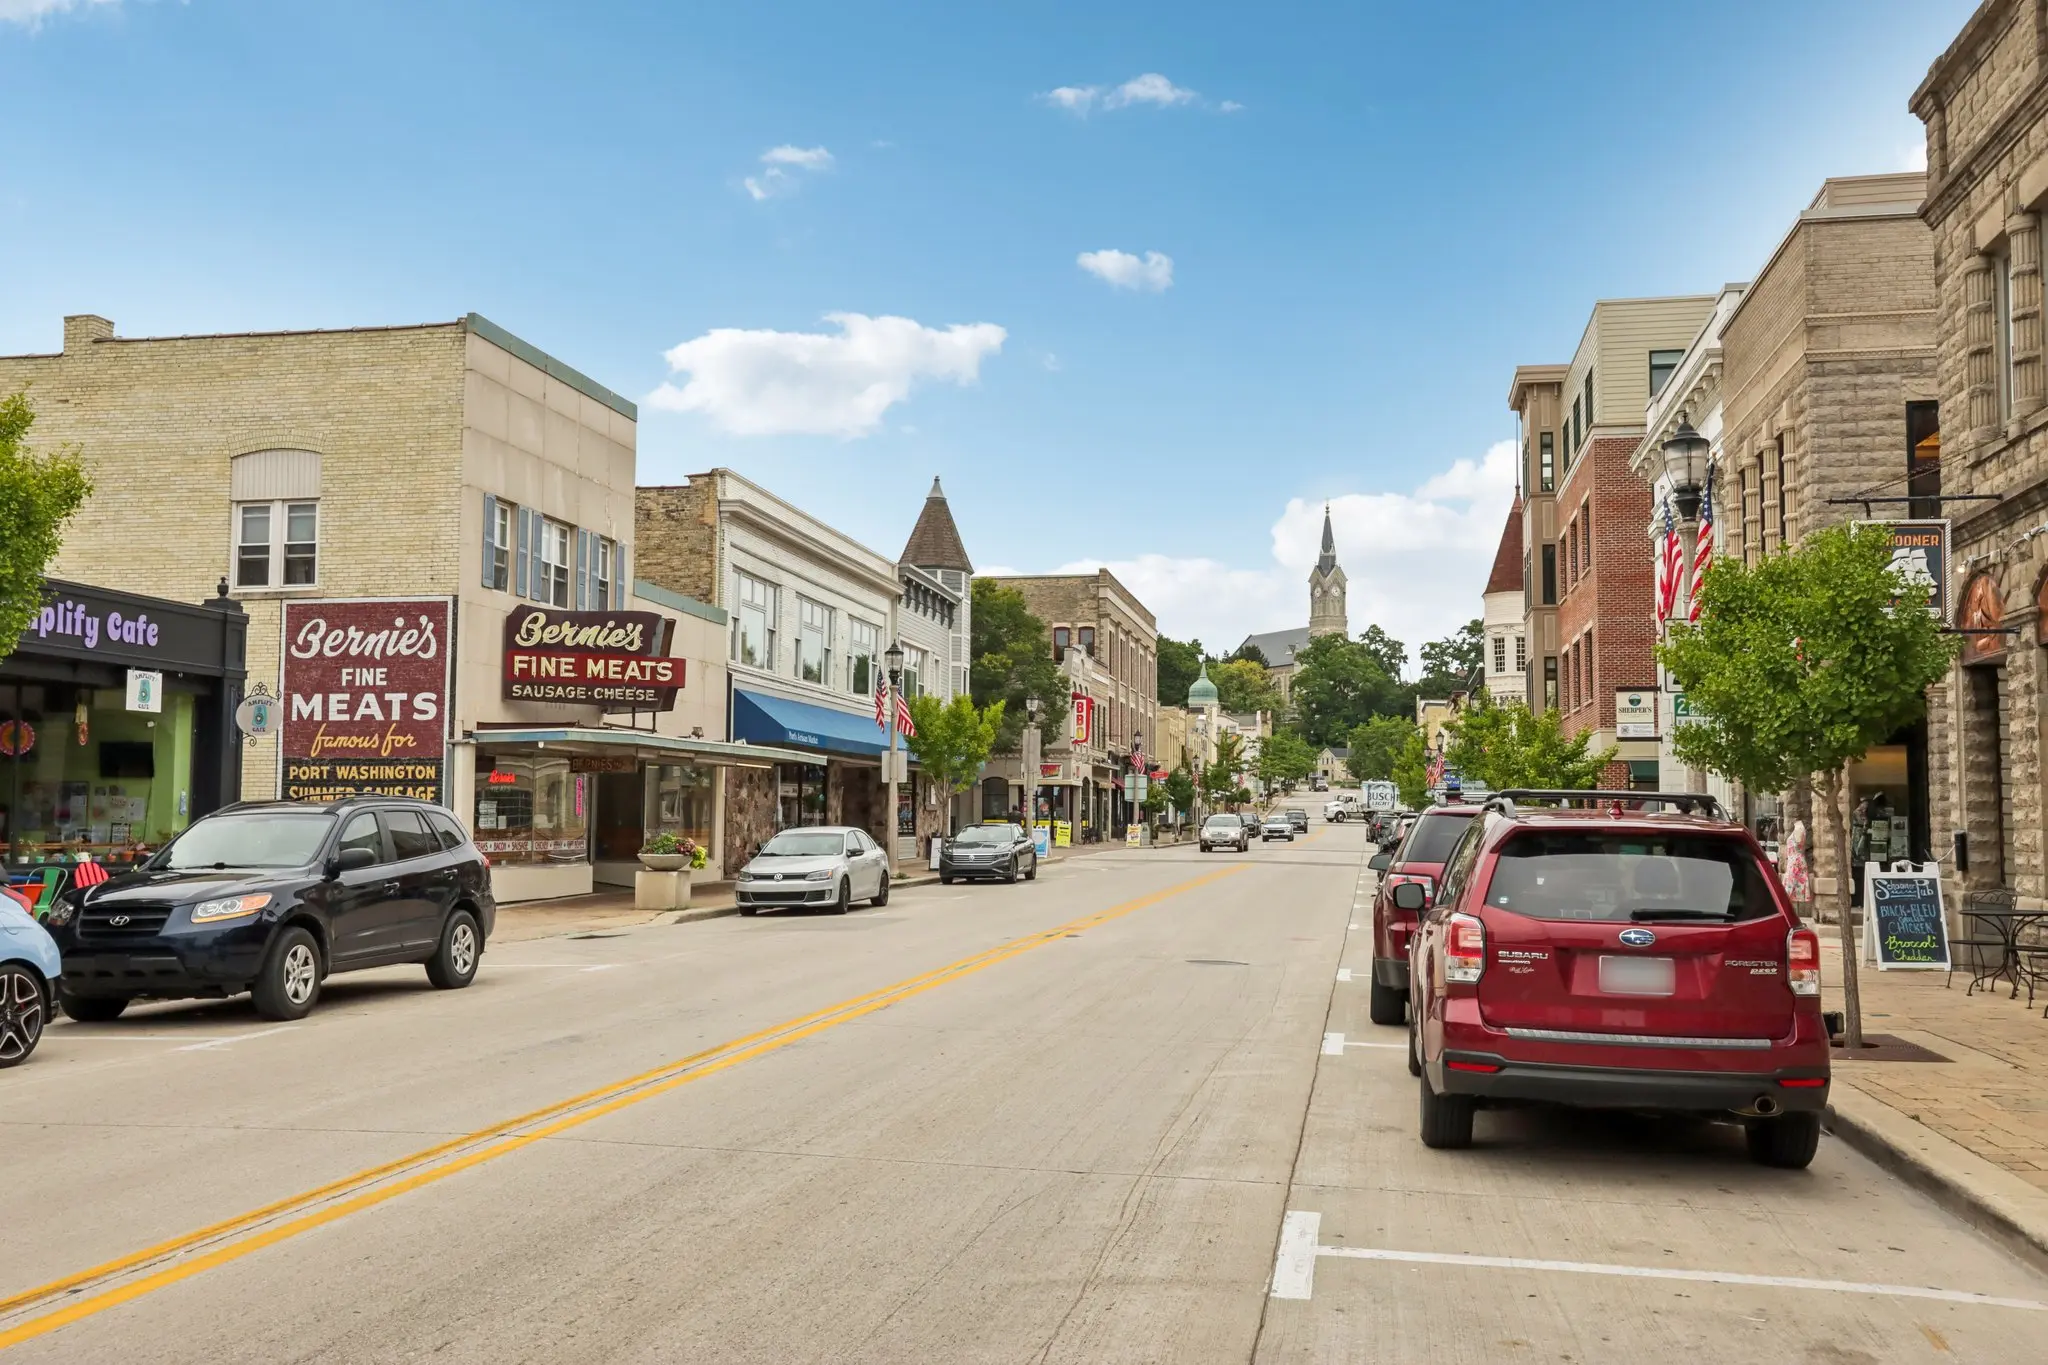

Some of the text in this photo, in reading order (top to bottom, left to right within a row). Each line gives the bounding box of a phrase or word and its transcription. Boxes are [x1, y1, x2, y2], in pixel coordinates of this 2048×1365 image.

[29, 600, 158, 648] plify Cafe
[514, 611, 643, 651] Bernie's
[291, 615, 437, 660] Bernie's
[341, 668, 388, 686] FINE
[513, 655, 673, 682] FINE MEATS
[512, 684, 658, 701] SAUSAGE CHEESE
[291, 692, 438, 722] MEATS
[1618, 706, 1652, 714] SHERPER'S
[311, 723, 417, 758] famous for
[289, 765, 436, 780] PORT WASHINGTON
[1368, 792, 1395, 801] BUSCH
[1914, 879, 1934, 899] Pub
[1885, 935, 1939, 949] Broccoli
[1498, 951, 1548, 959] SUBARU
